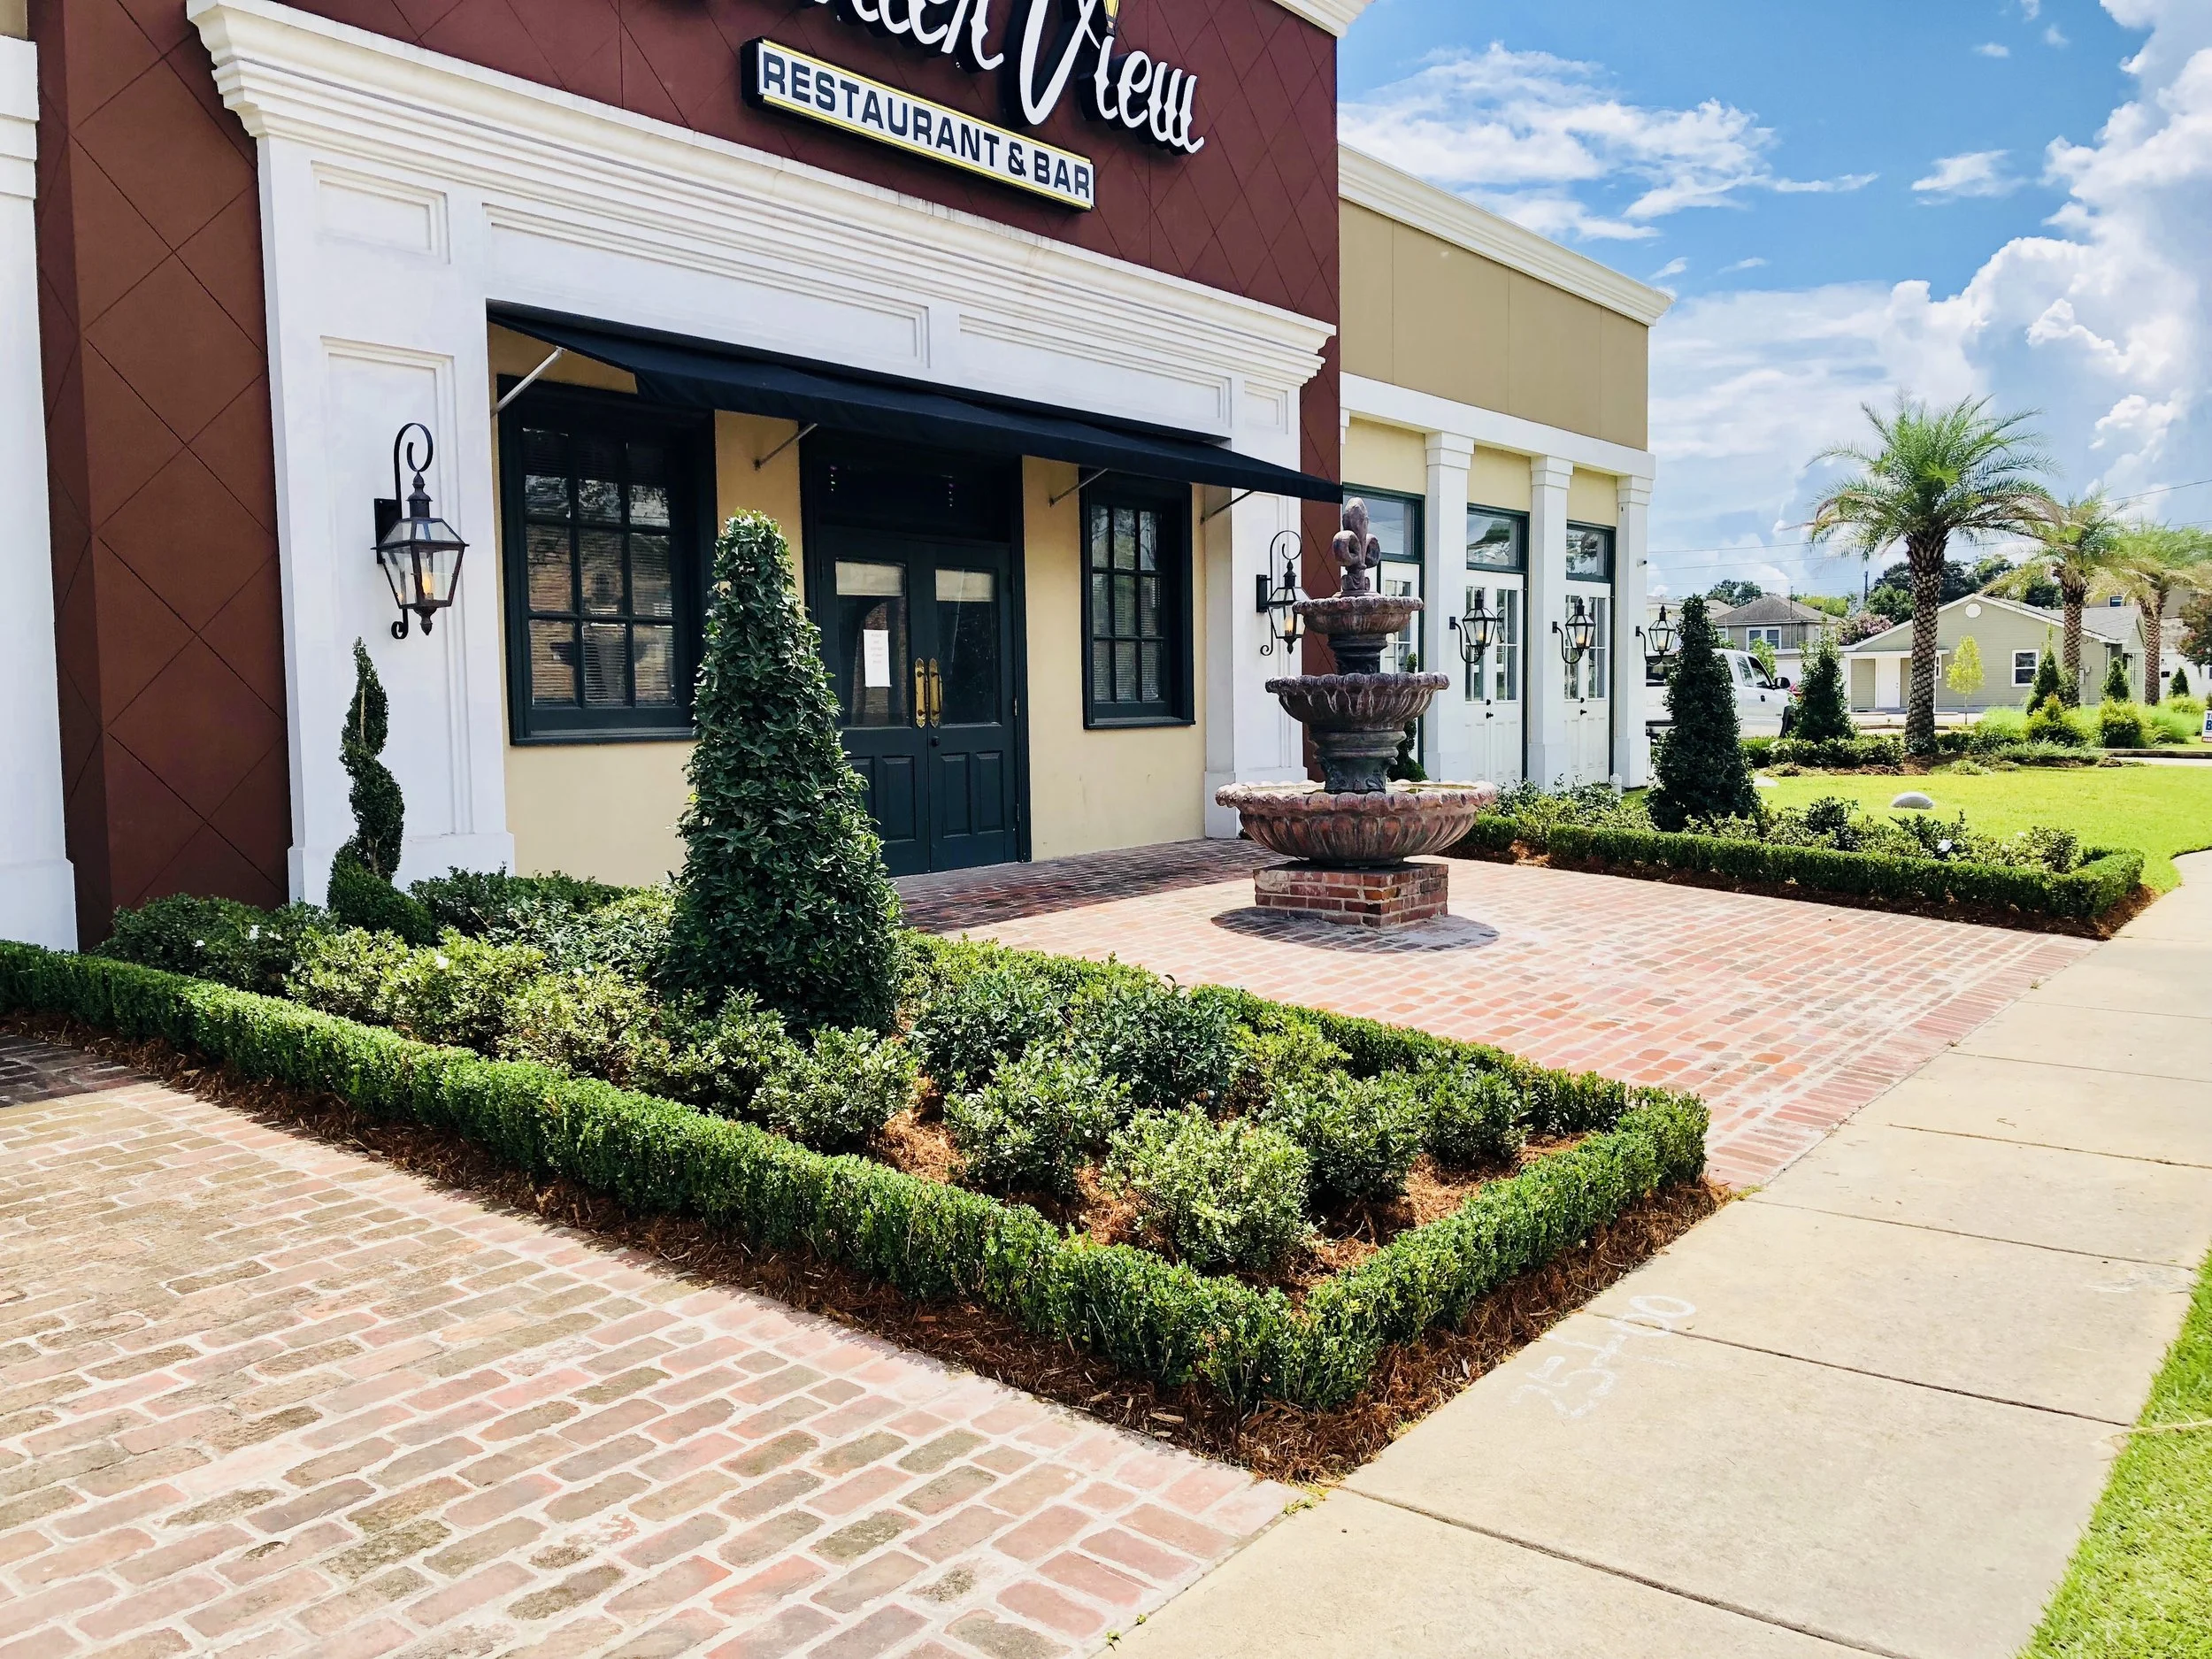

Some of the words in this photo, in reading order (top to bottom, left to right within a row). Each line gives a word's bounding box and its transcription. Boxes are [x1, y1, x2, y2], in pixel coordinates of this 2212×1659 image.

[763, 50, 1000, 167] RESTAURANT
[1008, 141, 1027, 177] &
[1033, 150, 1090, 199] BAR
[1019, 0, 1205, 154] View
